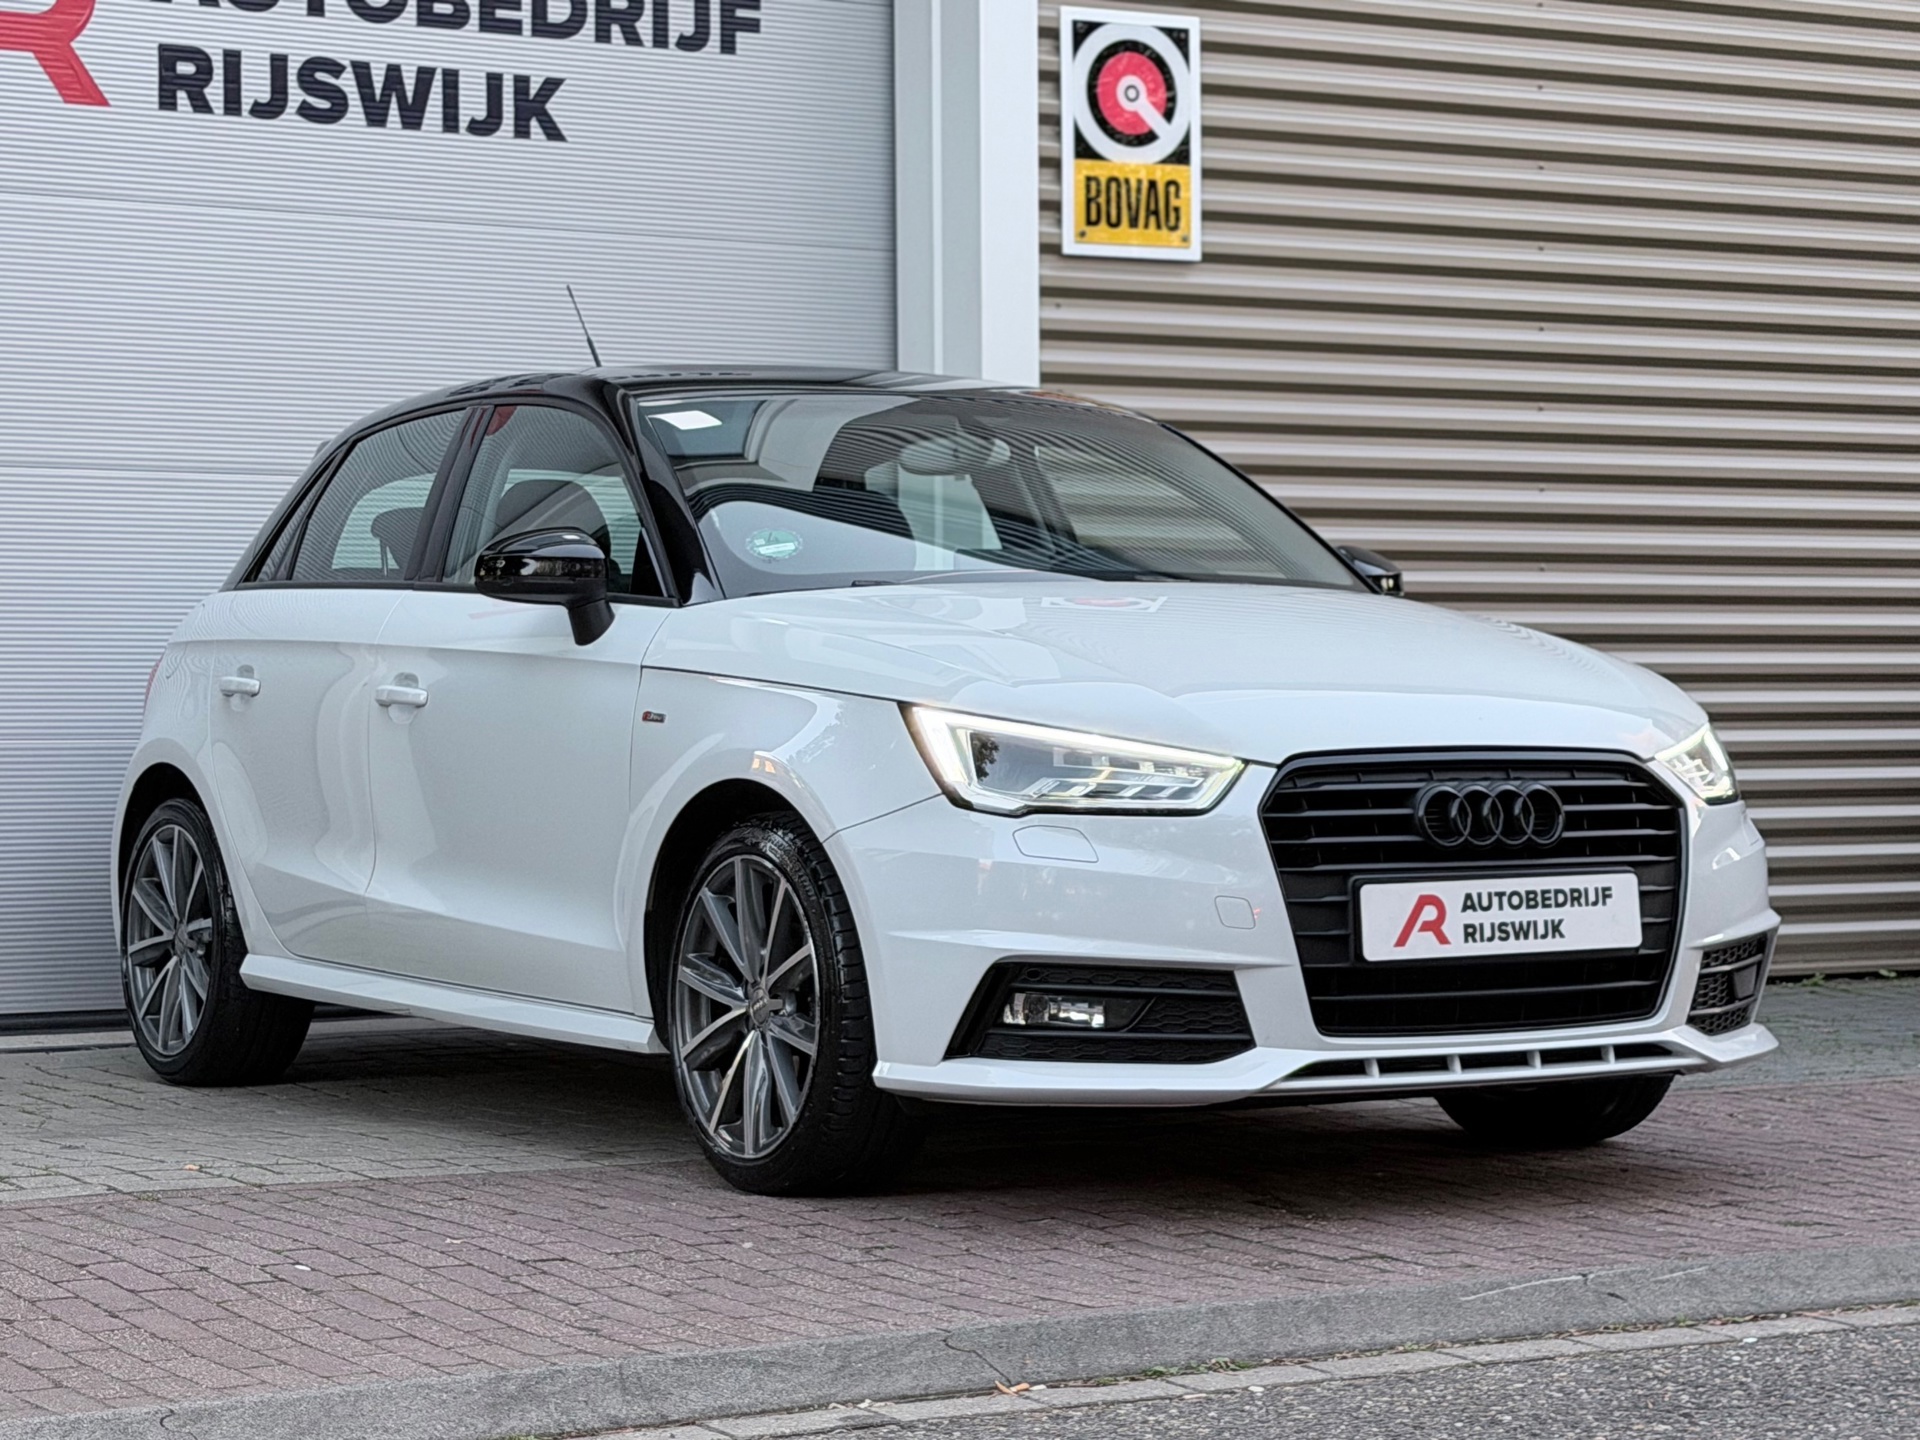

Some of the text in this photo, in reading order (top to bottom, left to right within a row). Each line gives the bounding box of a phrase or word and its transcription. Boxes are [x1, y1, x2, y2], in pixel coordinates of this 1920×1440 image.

[157, 43, 569, 142] RIJSWIJK
[1085, 176, 1181, 231] BOVAG
[1460, 886, 1613, 913] AUTOBEDRIJF
[1462, 918, 1566, 944] RIJSWIJK
